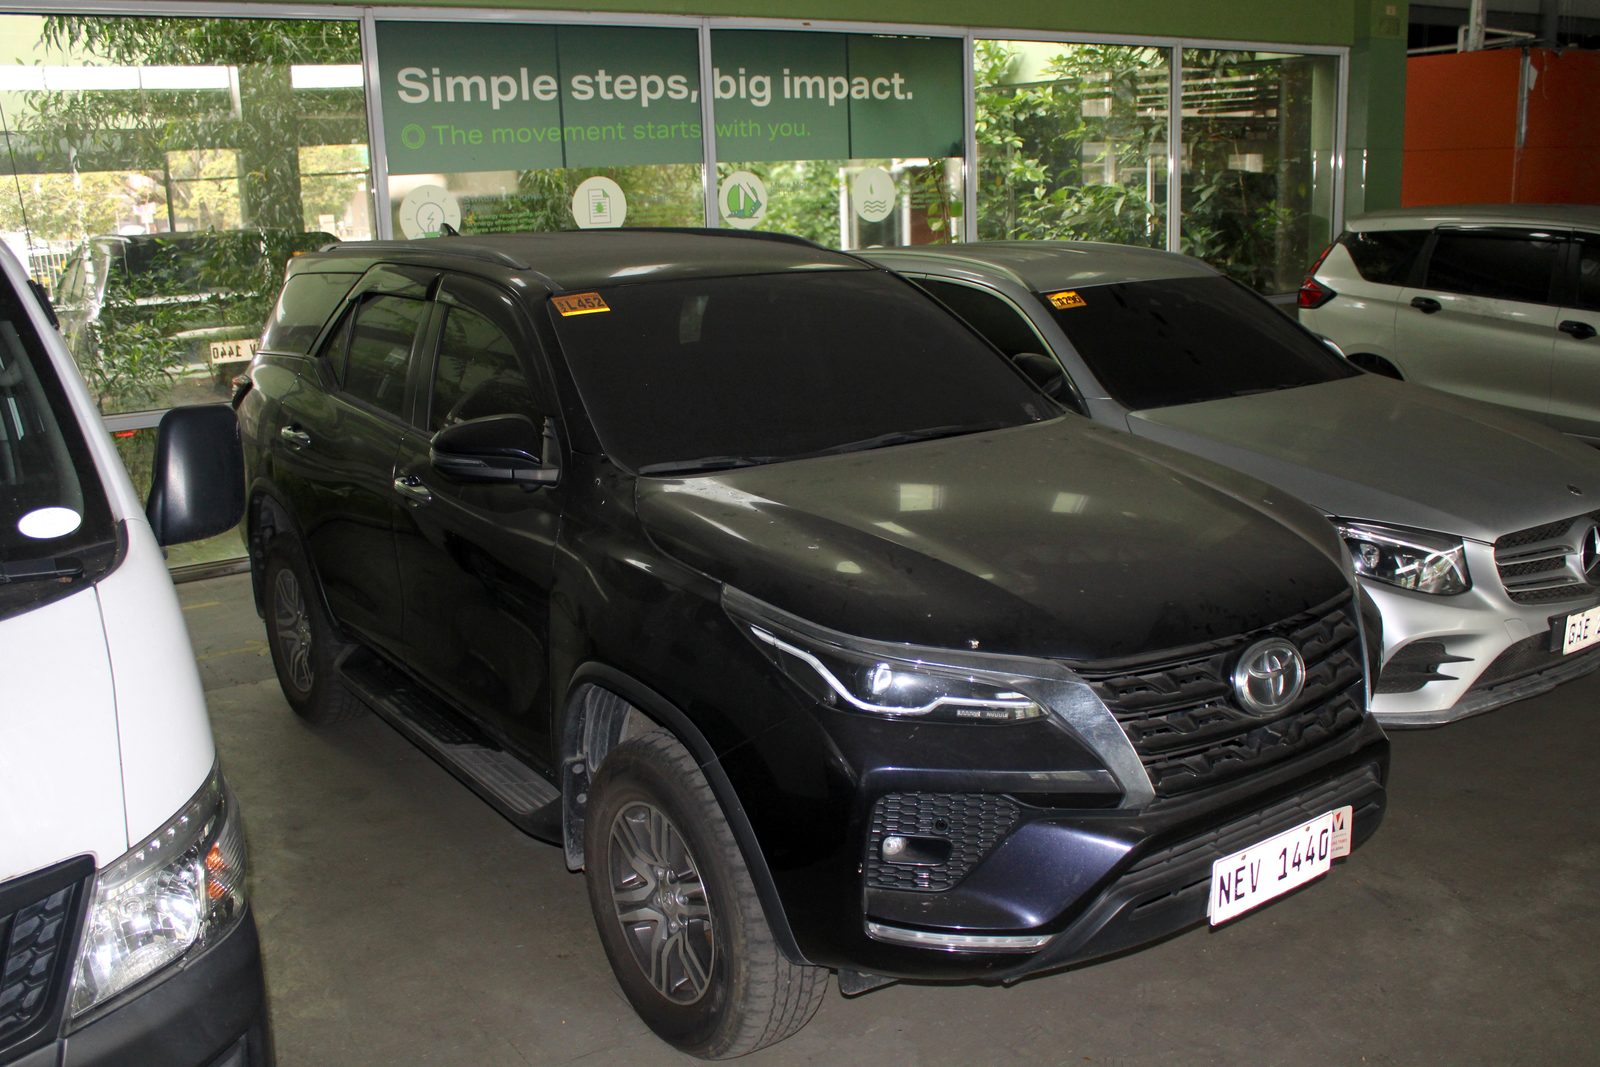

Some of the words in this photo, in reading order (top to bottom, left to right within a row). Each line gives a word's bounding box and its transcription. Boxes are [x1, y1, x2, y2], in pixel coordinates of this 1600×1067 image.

[397, 67, 558, 110] Simple
[571, 69, 698, 107] steps,
[713, 67, 771, 107] big
[783, 68, 913, 106] impact.
[431, 125, 483, 145] The
[491, 122, 626, 144] movement
[633, 121, 700, 140] starts
[715, 119, 761, 137] with
[768, 121, 811, 141] you.
[1219, 859, 1261, 908] NEV
[1277, 828, 1329, 881] 1440
